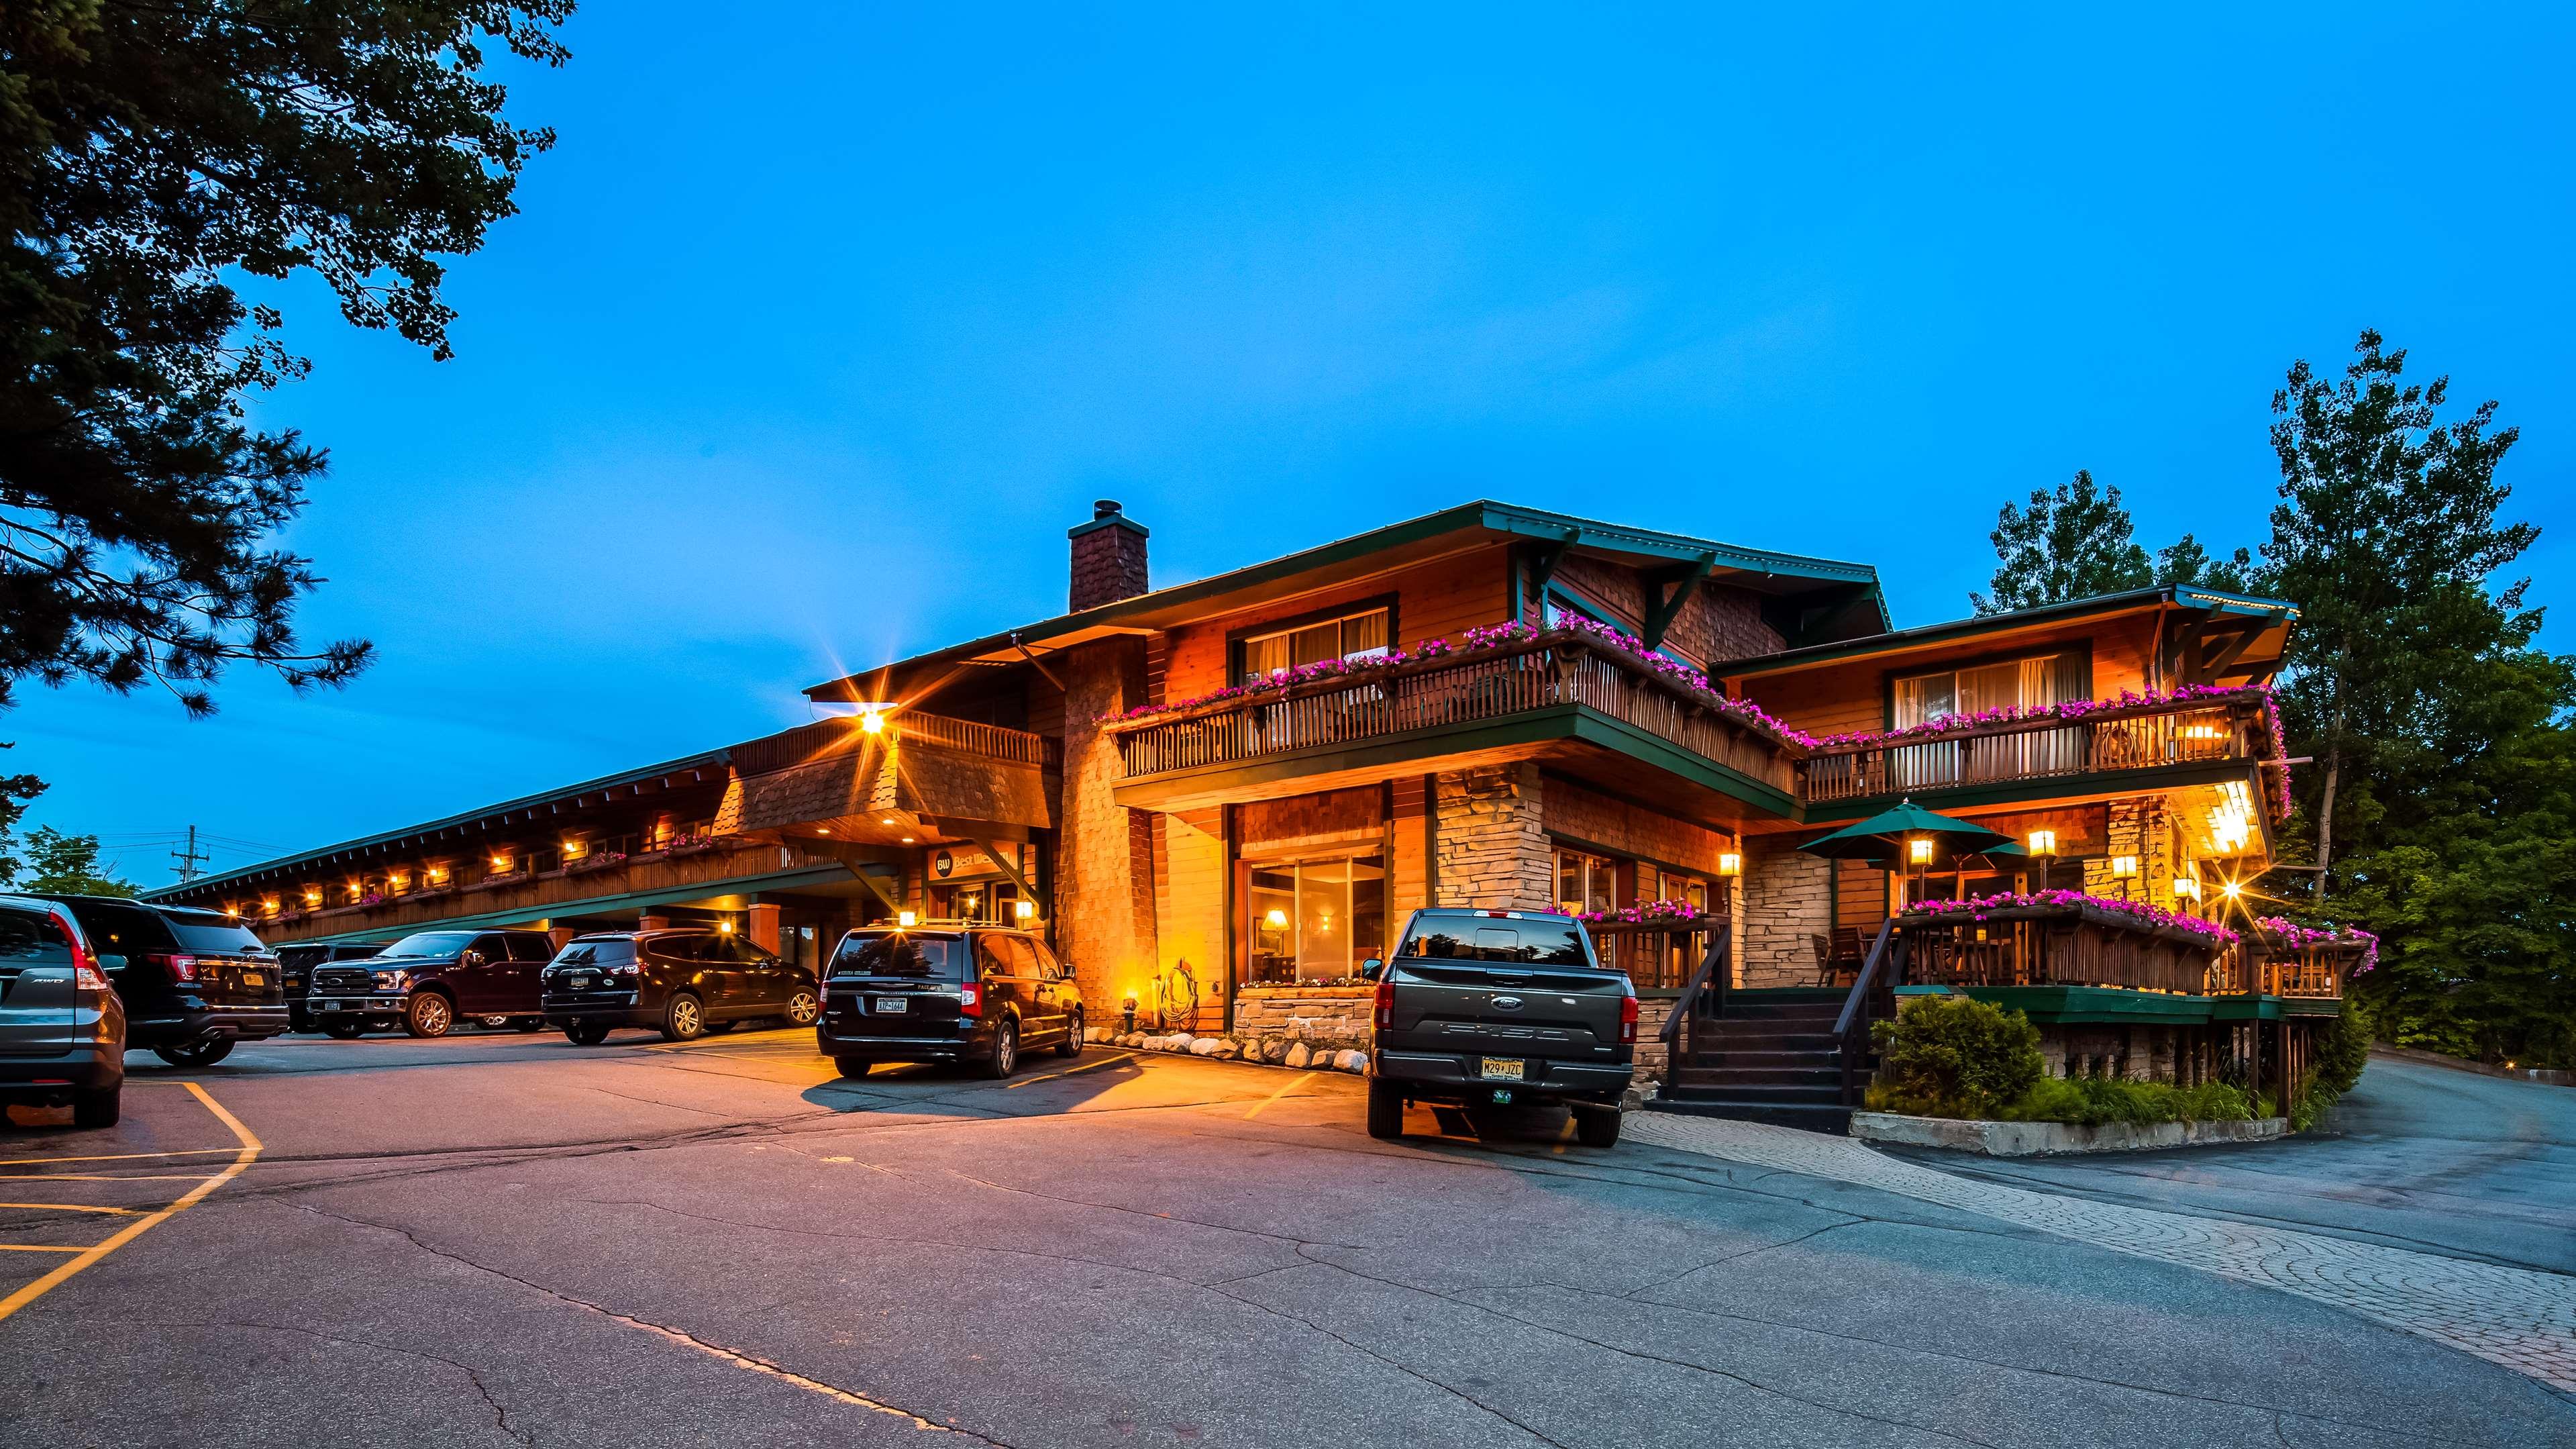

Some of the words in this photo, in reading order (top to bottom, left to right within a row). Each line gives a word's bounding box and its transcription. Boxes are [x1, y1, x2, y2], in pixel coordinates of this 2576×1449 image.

[937, 859, 950, 870] BW
[954, 855, 974, 868] Best
[974, 852, 1009, 864] Wesn
[1498, 999, 1517, 1007] Ford
